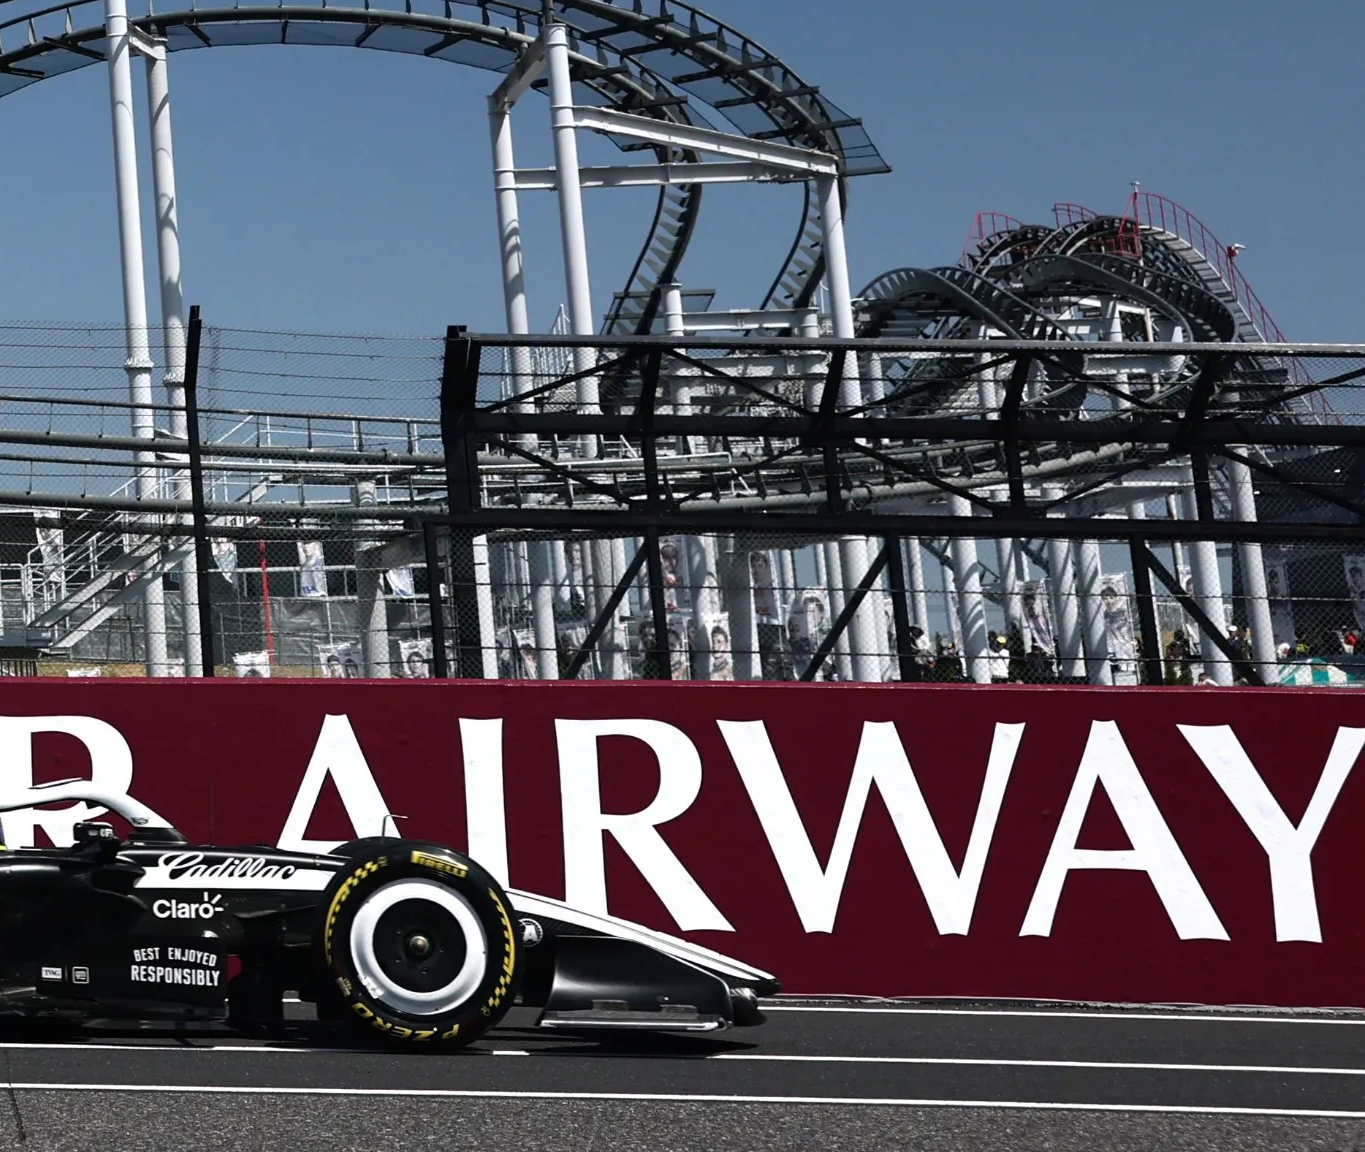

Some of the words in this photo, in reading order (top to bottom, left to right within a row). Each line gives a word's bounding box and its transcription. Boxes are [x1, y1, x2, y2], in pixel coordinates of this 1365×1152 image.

[158, 851, 296, 880] Cadillac
[411, 850, 468, 878] PIRELLI
[152, 898, 215, 919] Claro
[133, 947, 160, 962] BEST
[168, 947, 218, 967] ENJOYED
[130, 965, 220, 987] RESPONSIBLY
[351, 1002, 435, 1042] ZERO
[441, 1023, 460, 1040] P
